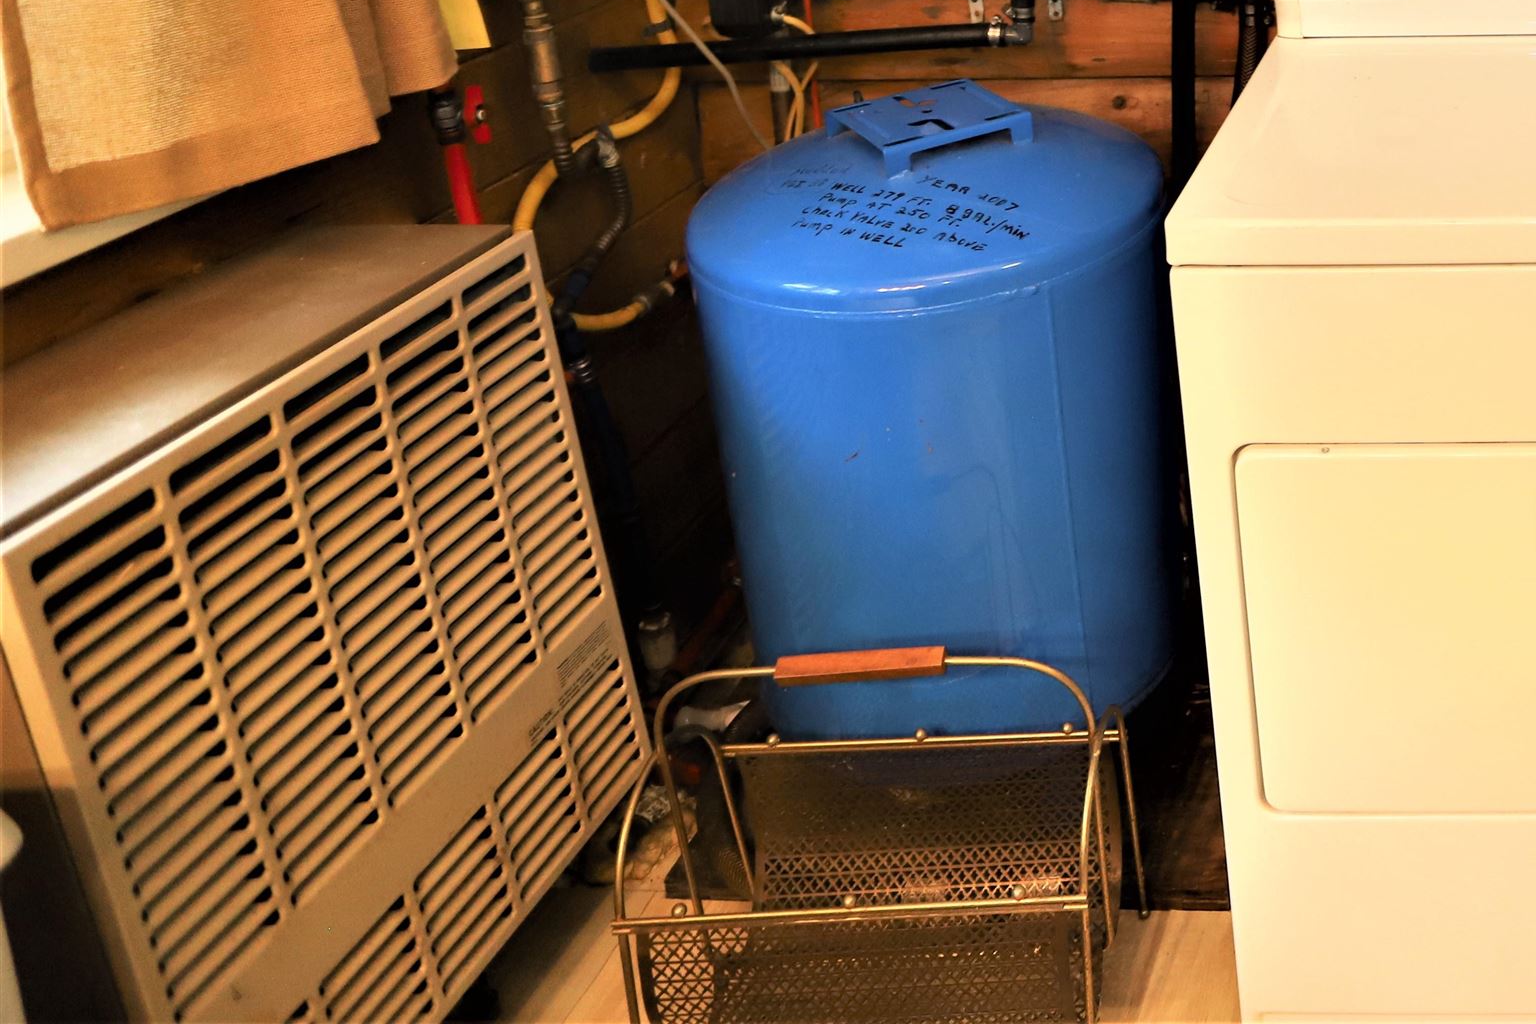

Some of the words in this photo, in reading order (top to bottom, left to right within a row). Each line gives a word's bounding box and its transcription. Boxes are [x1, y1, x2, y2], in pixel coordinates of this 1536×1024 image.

[831, 182, 866, 194] WELL
[872, 189, 906, 201] 279
[907, 196, 932, 205] FT.
[916, 175, 970, 195] YEAR
[977, 193, 1019, 211] 2007
[896, 207, 931, 219] 250
[937, 215, 962, 226] FT.
[860, 232, 906, 248] WELL
